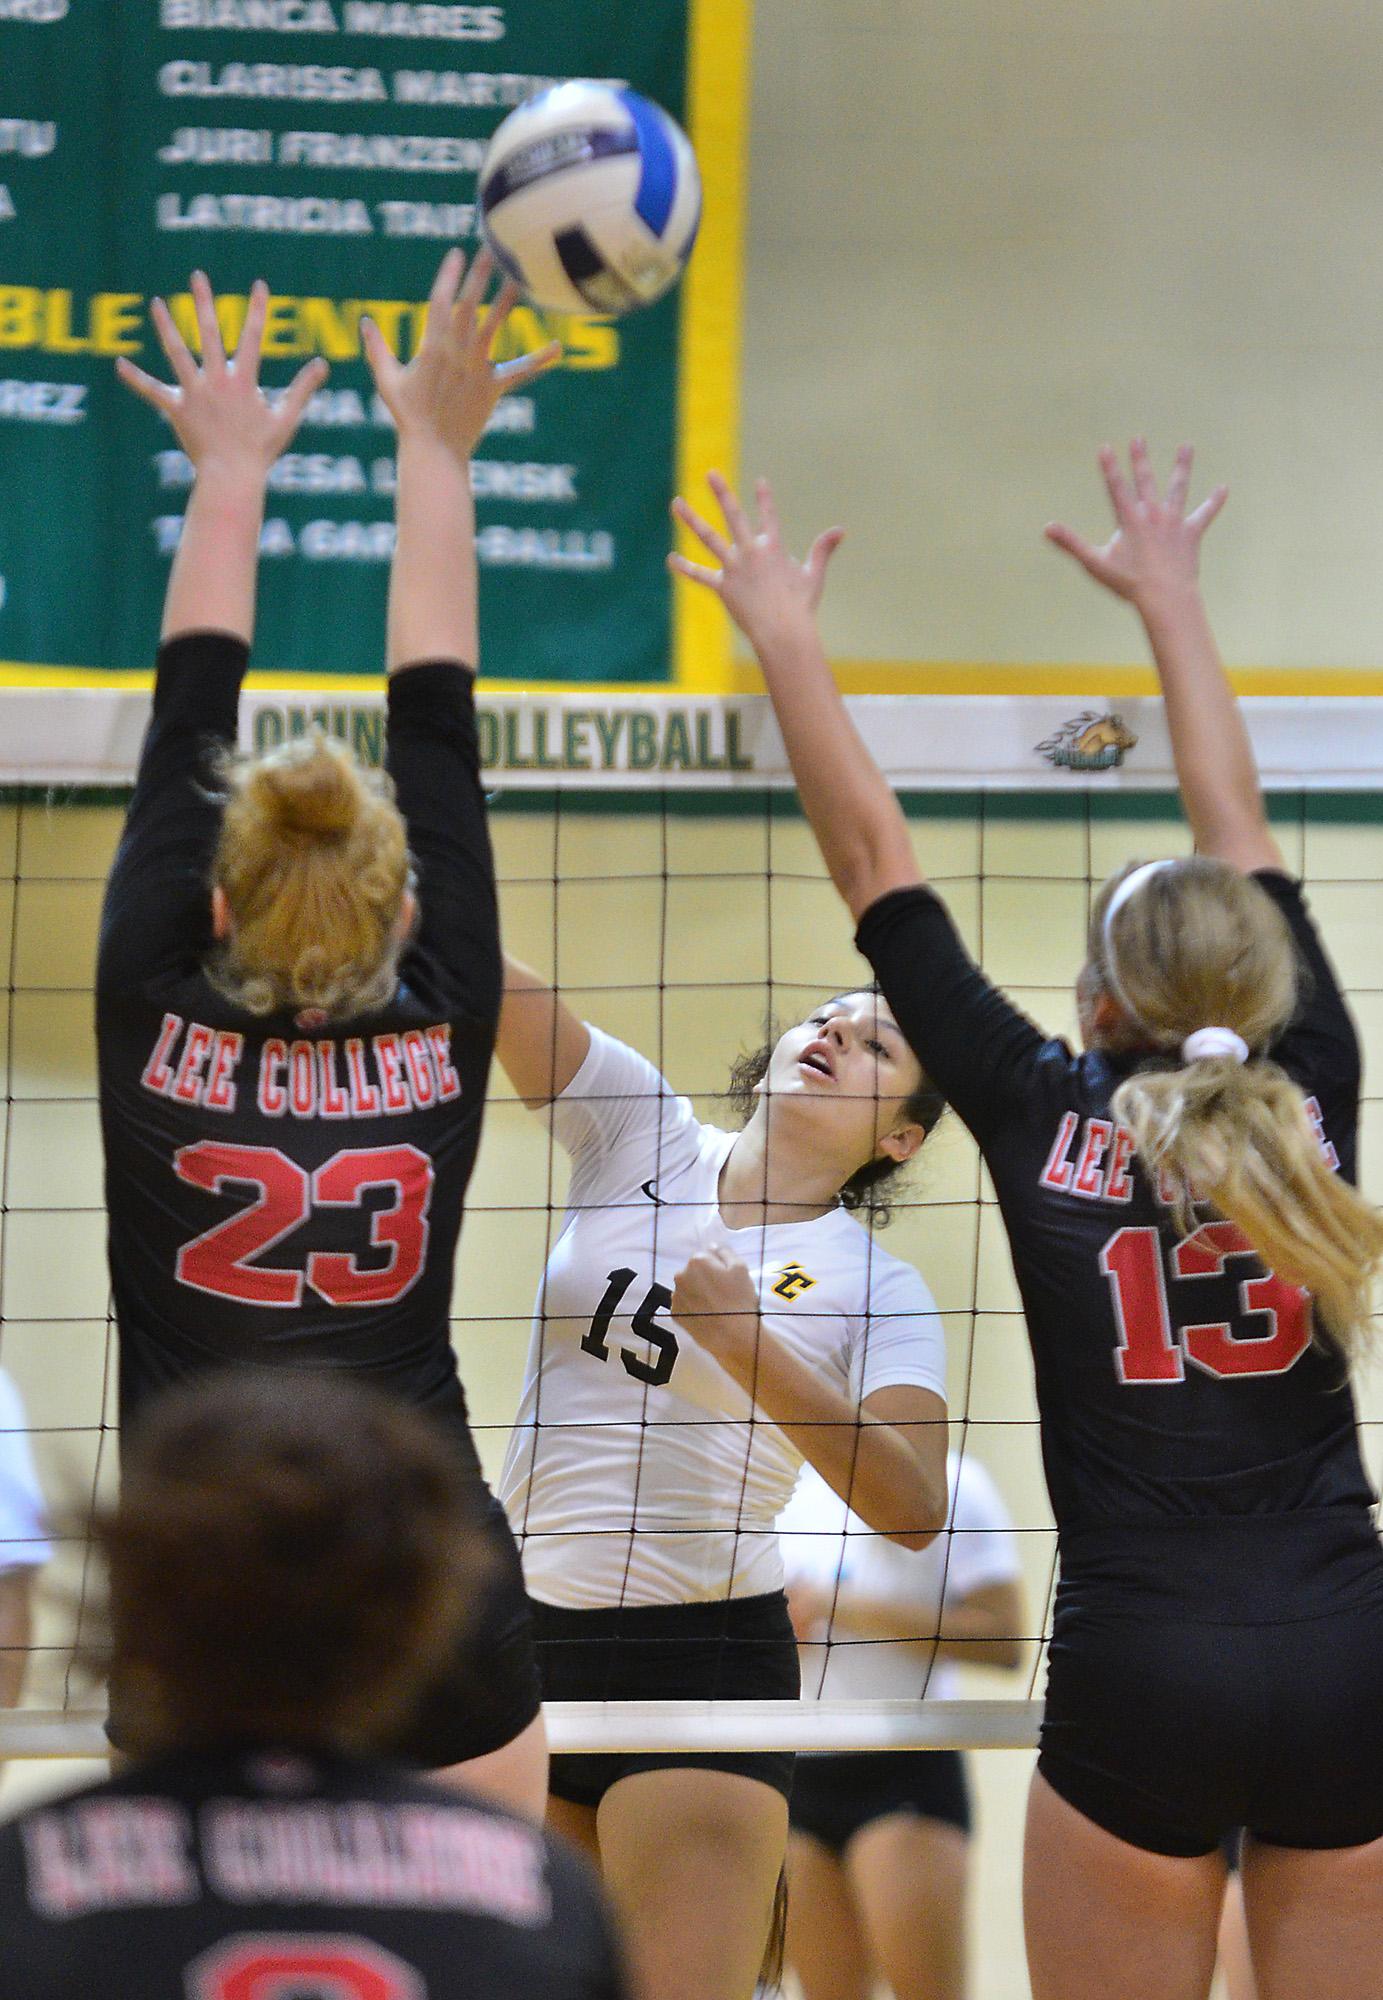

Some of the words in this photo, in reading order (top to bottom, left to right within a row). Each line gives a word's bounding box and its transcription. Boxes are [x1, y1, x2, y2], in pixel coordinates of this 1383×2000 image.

[160, 0, 338, 32] BIANCA
[343, 2, 505, 41] MARES
[158, 60, 388, 101] CLARISSA
[393, 70, 628, 106] MARTI
[158, 127, 271, 164] JURI
[156, 192, 373, 235] LATRICIA
[477, 707, 755, 770] OLLEYBALL
[141, 1012, 243, 1113] LEE
[257, 1022, 462, 1120] COLLEGE
[1039, 1110, 1137, 1205] LEE
[173, 1140, 435, 1308] 23
[580, 1267, 679, 1387] 15
[1099, 1218, 1313, 1385] 13
